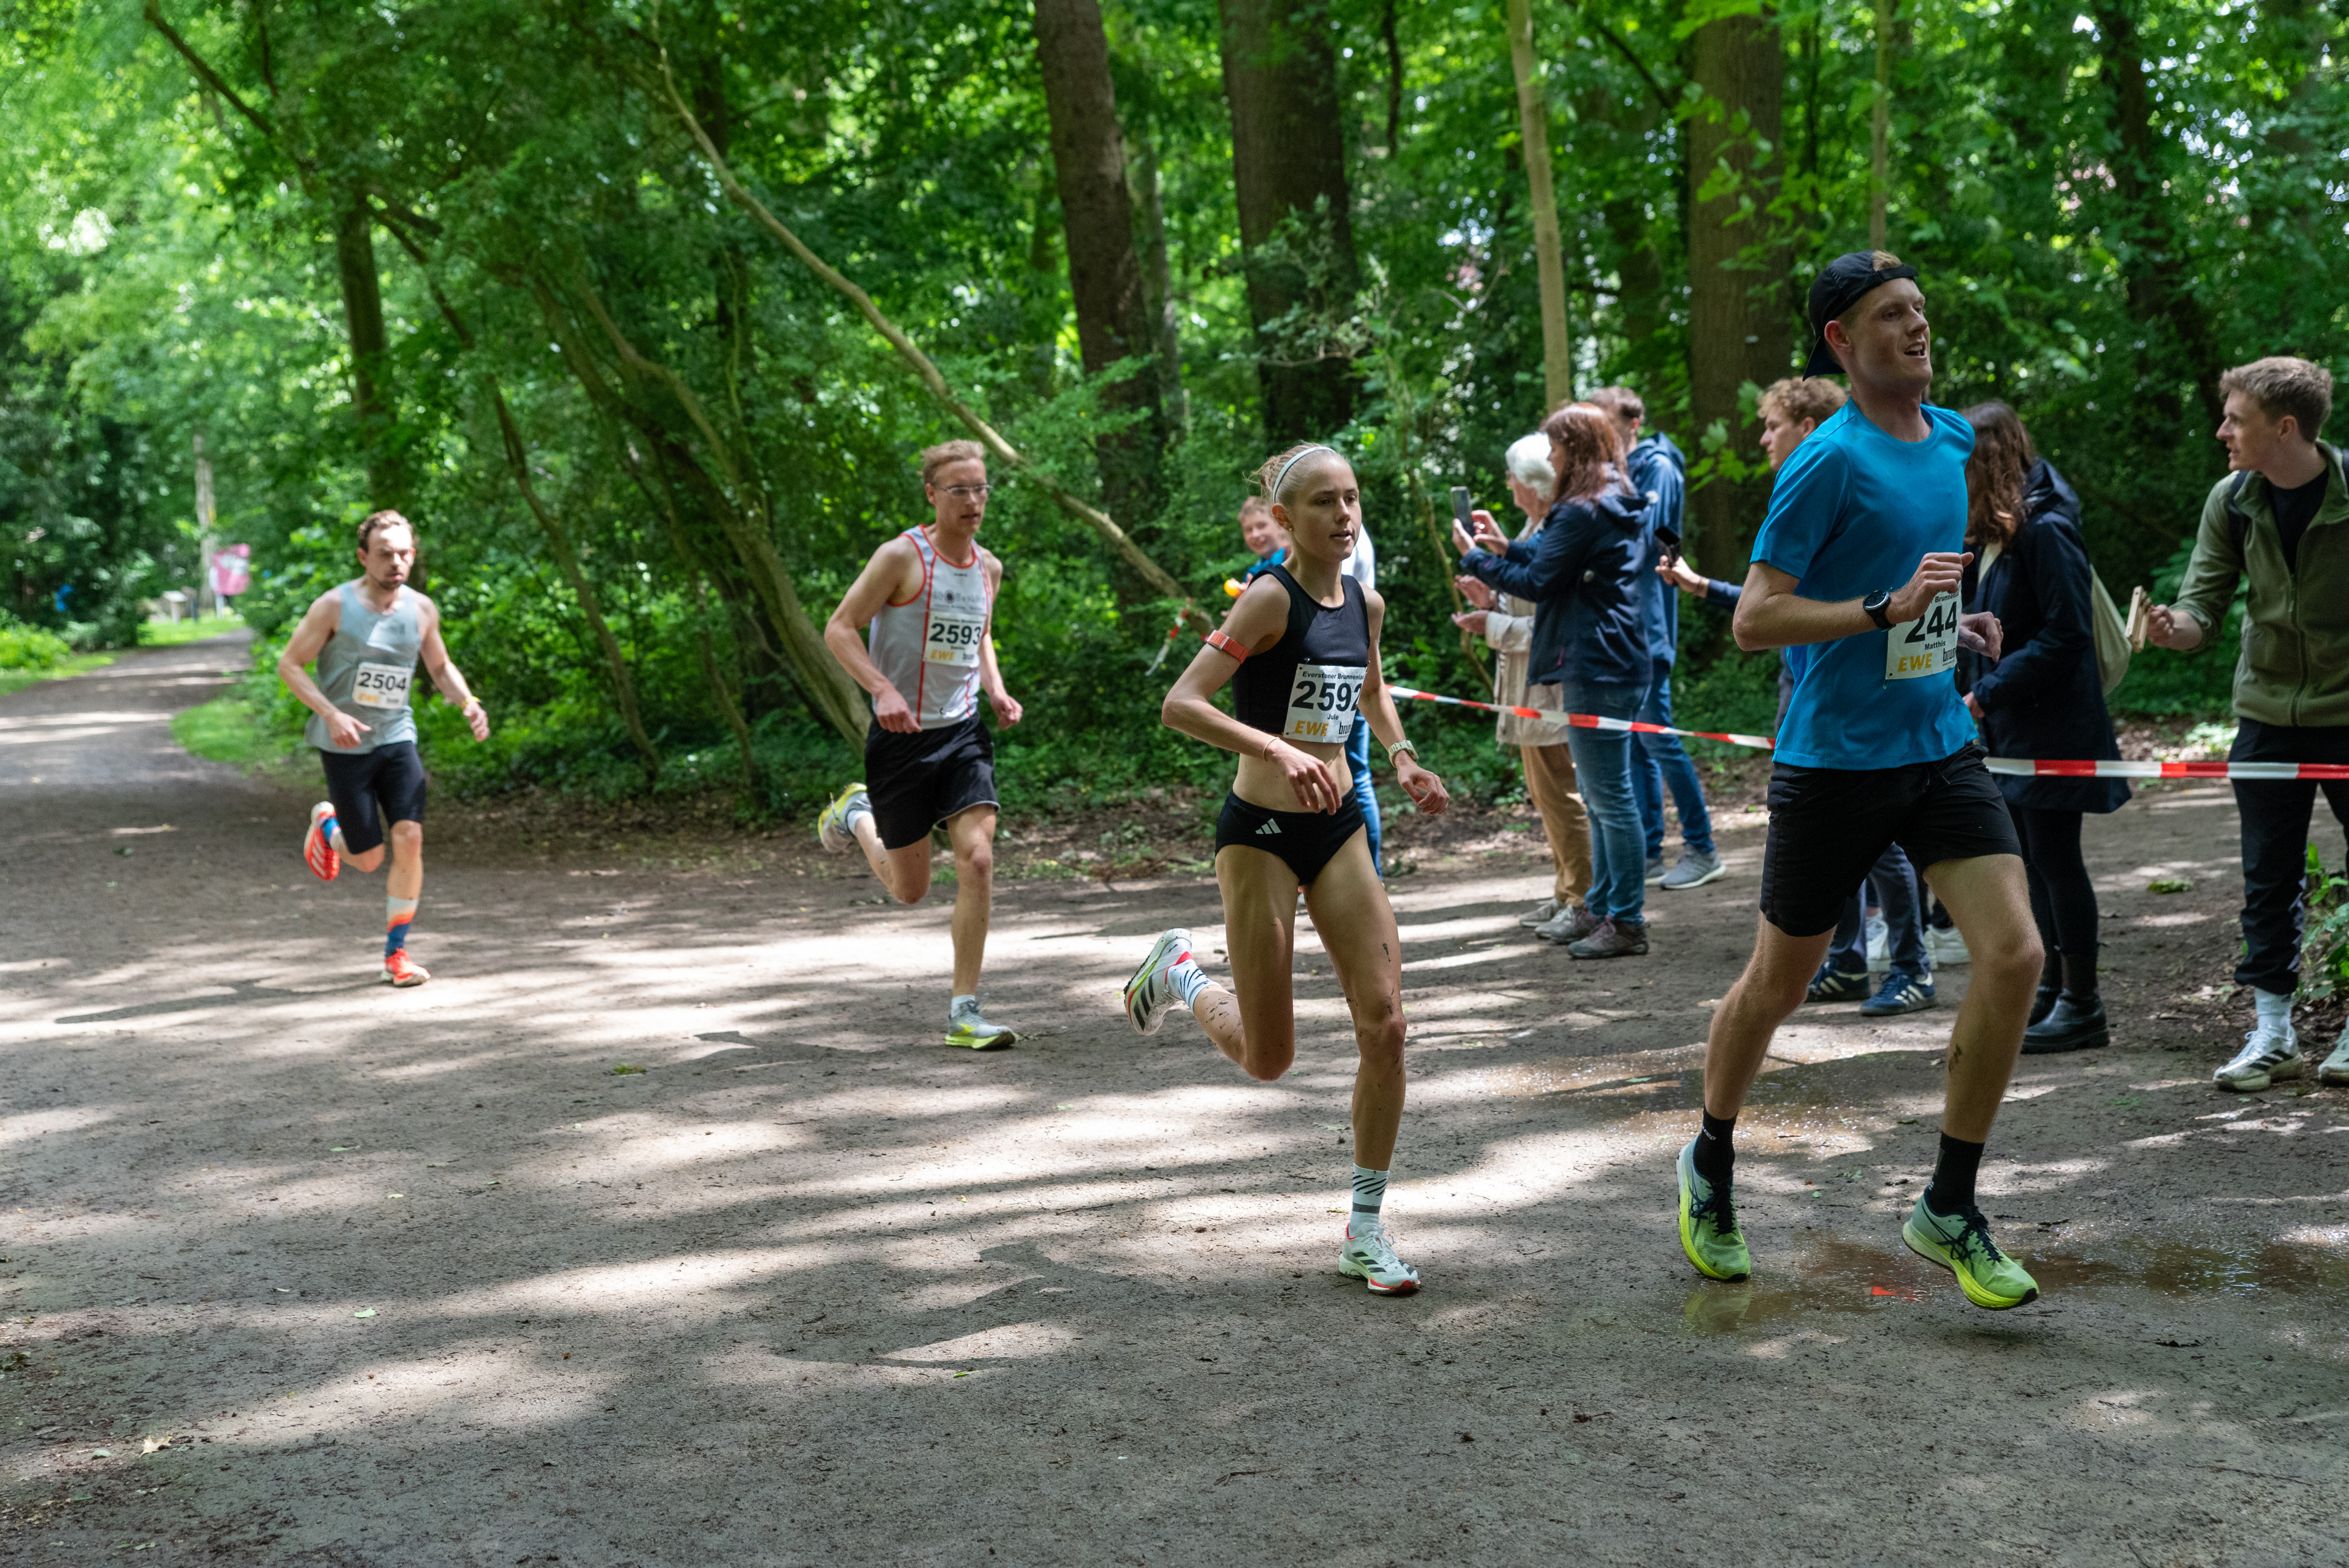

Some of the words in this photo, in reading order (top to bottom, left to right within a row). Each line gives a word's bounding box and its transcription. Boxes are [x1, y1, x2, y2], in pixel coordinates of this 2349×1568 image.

[1904, 601, 1958, 644] 244
[929, 622, 981, 645] 2593
[1925, 640, 1946, 650] Matthis
[1897, 652, 1933, 672] EWE
[358, 672, 407, 691] 2504
[1291, 680, 1362, 712] 2592
[1294, 720, 1330, 737] EWE
